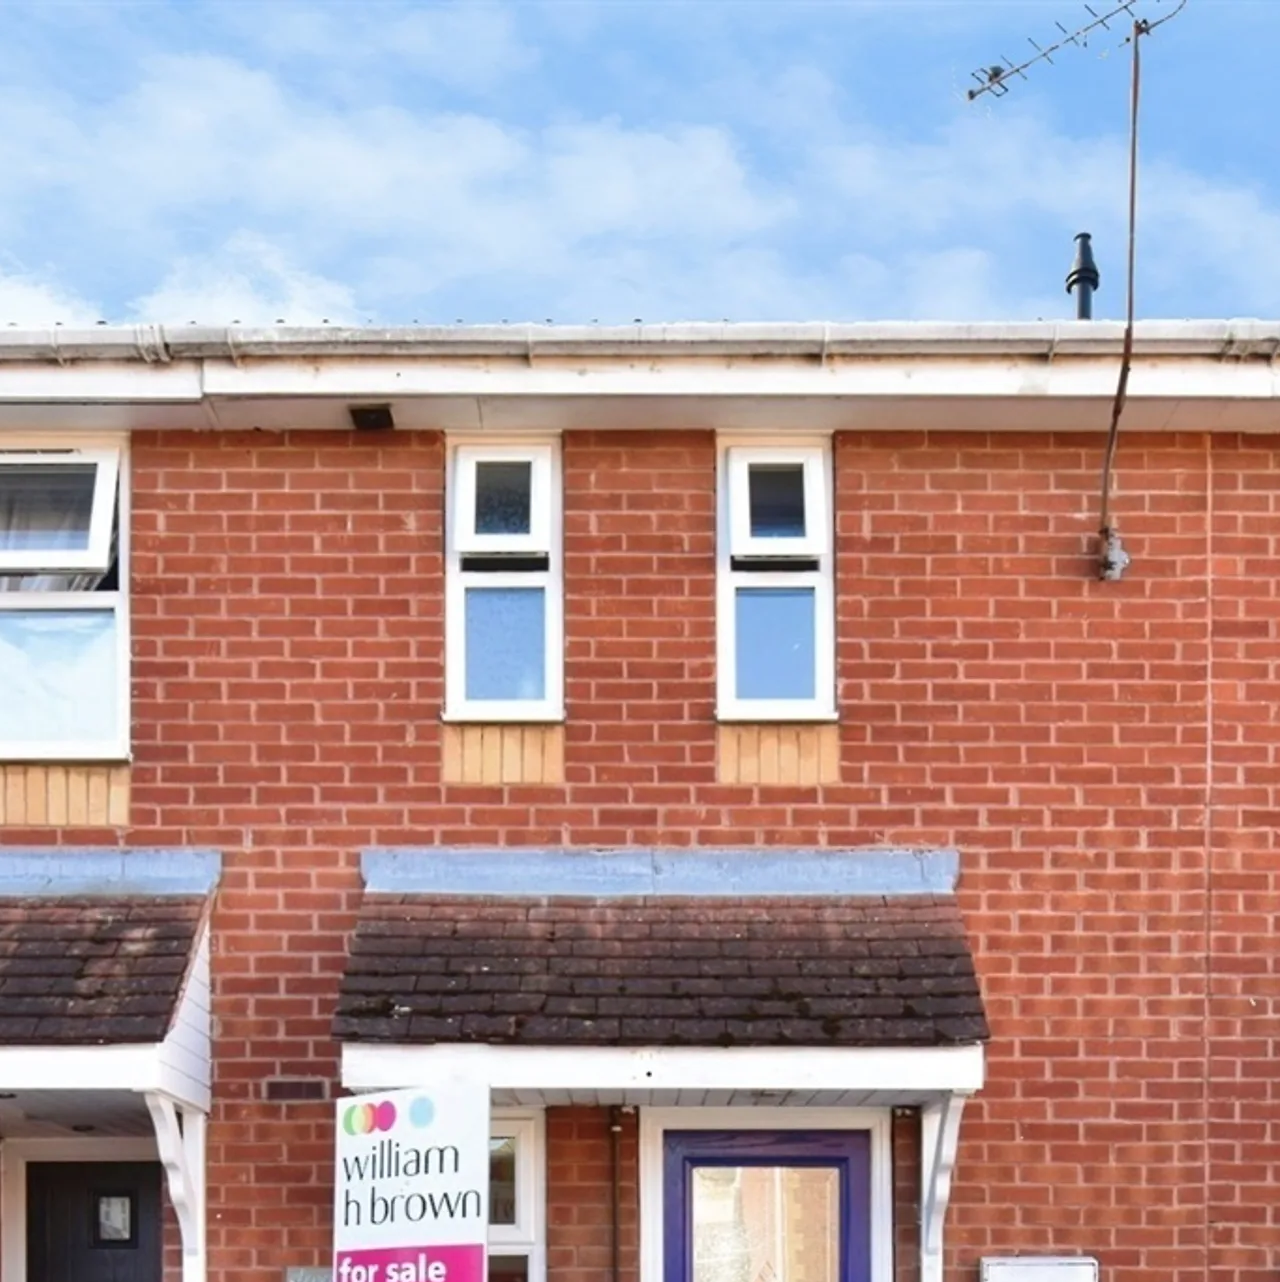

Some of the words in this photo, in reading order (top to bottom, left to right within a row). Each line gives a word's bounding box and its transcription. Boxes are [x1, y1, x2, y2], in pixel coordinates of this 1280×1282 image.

[343, 1139, 460, 1182] william
[343, 1189, 361, 1227] h
[371, 1186, 482, 1226] brown
